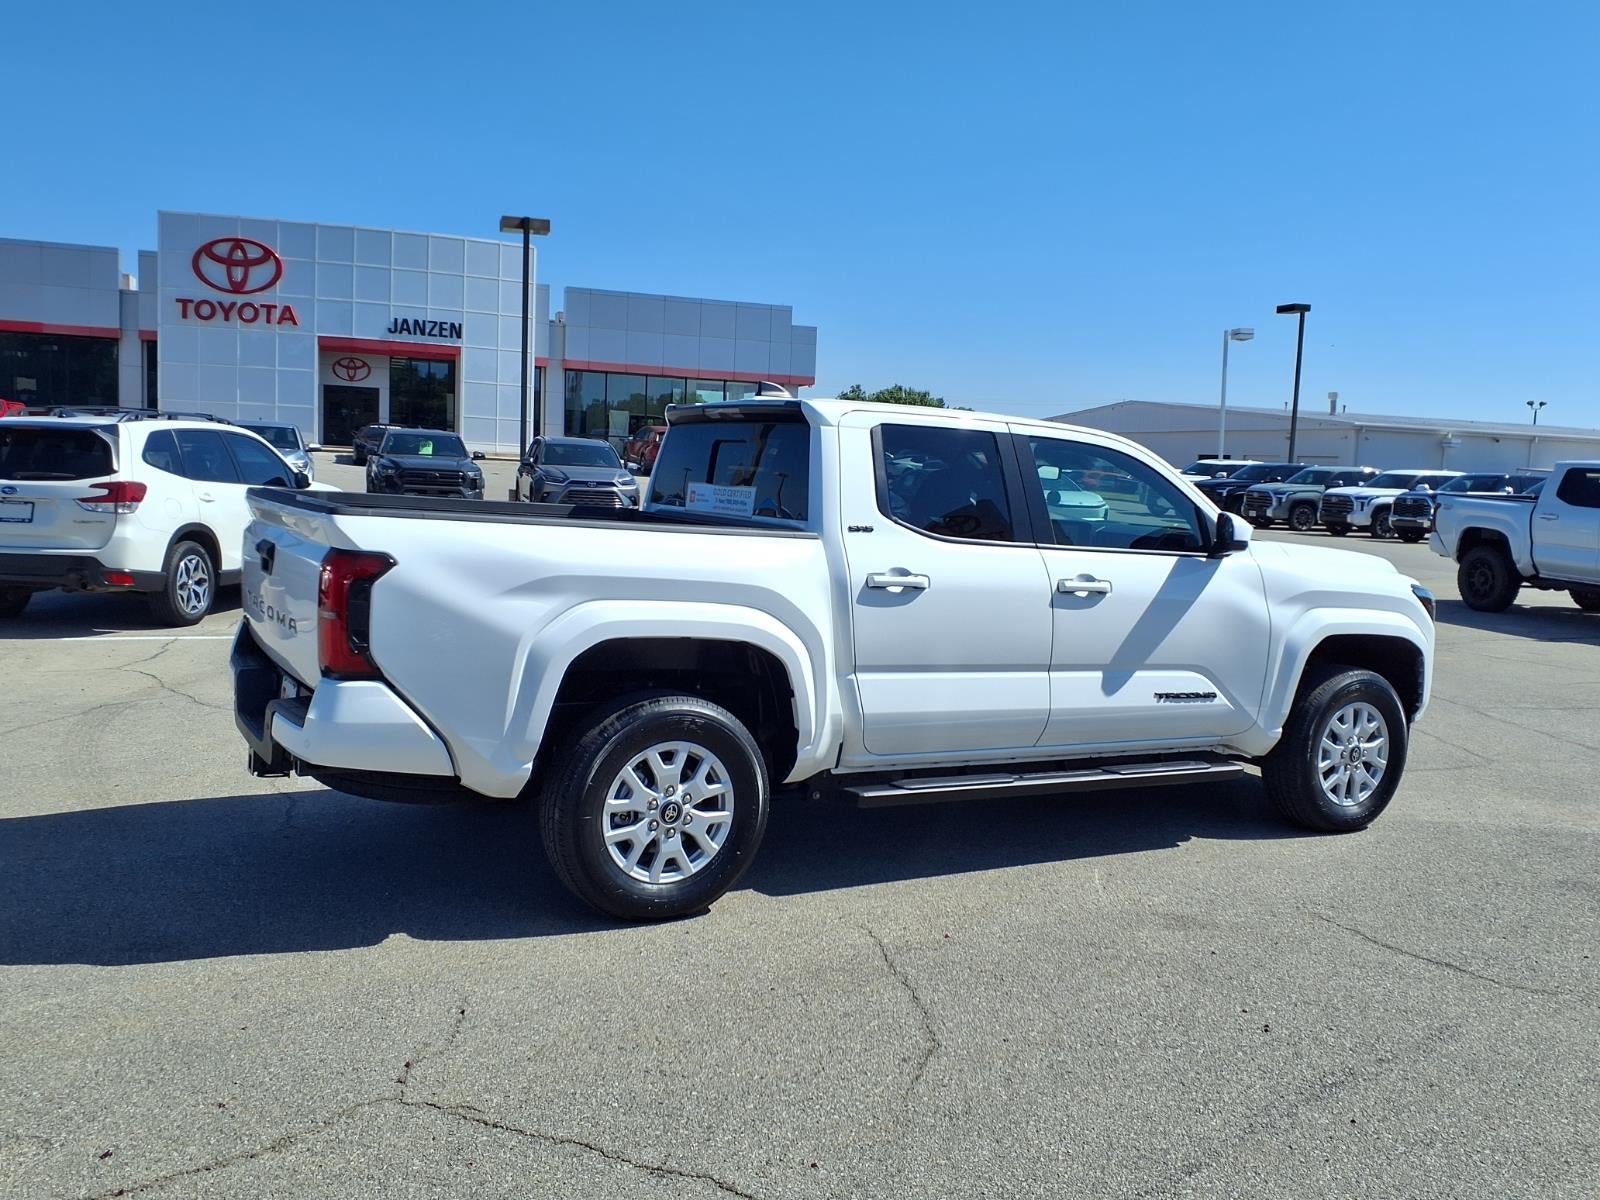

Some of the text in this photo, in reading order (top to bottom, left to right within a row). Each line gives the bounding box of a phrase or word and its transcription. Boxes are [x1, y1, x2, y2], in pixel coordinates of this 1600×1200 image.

[175, 297, 298, 326] TOYOTA
[387, 317, 463, 340] JANZEN
[247, 589, 298, 635] TACOMA
